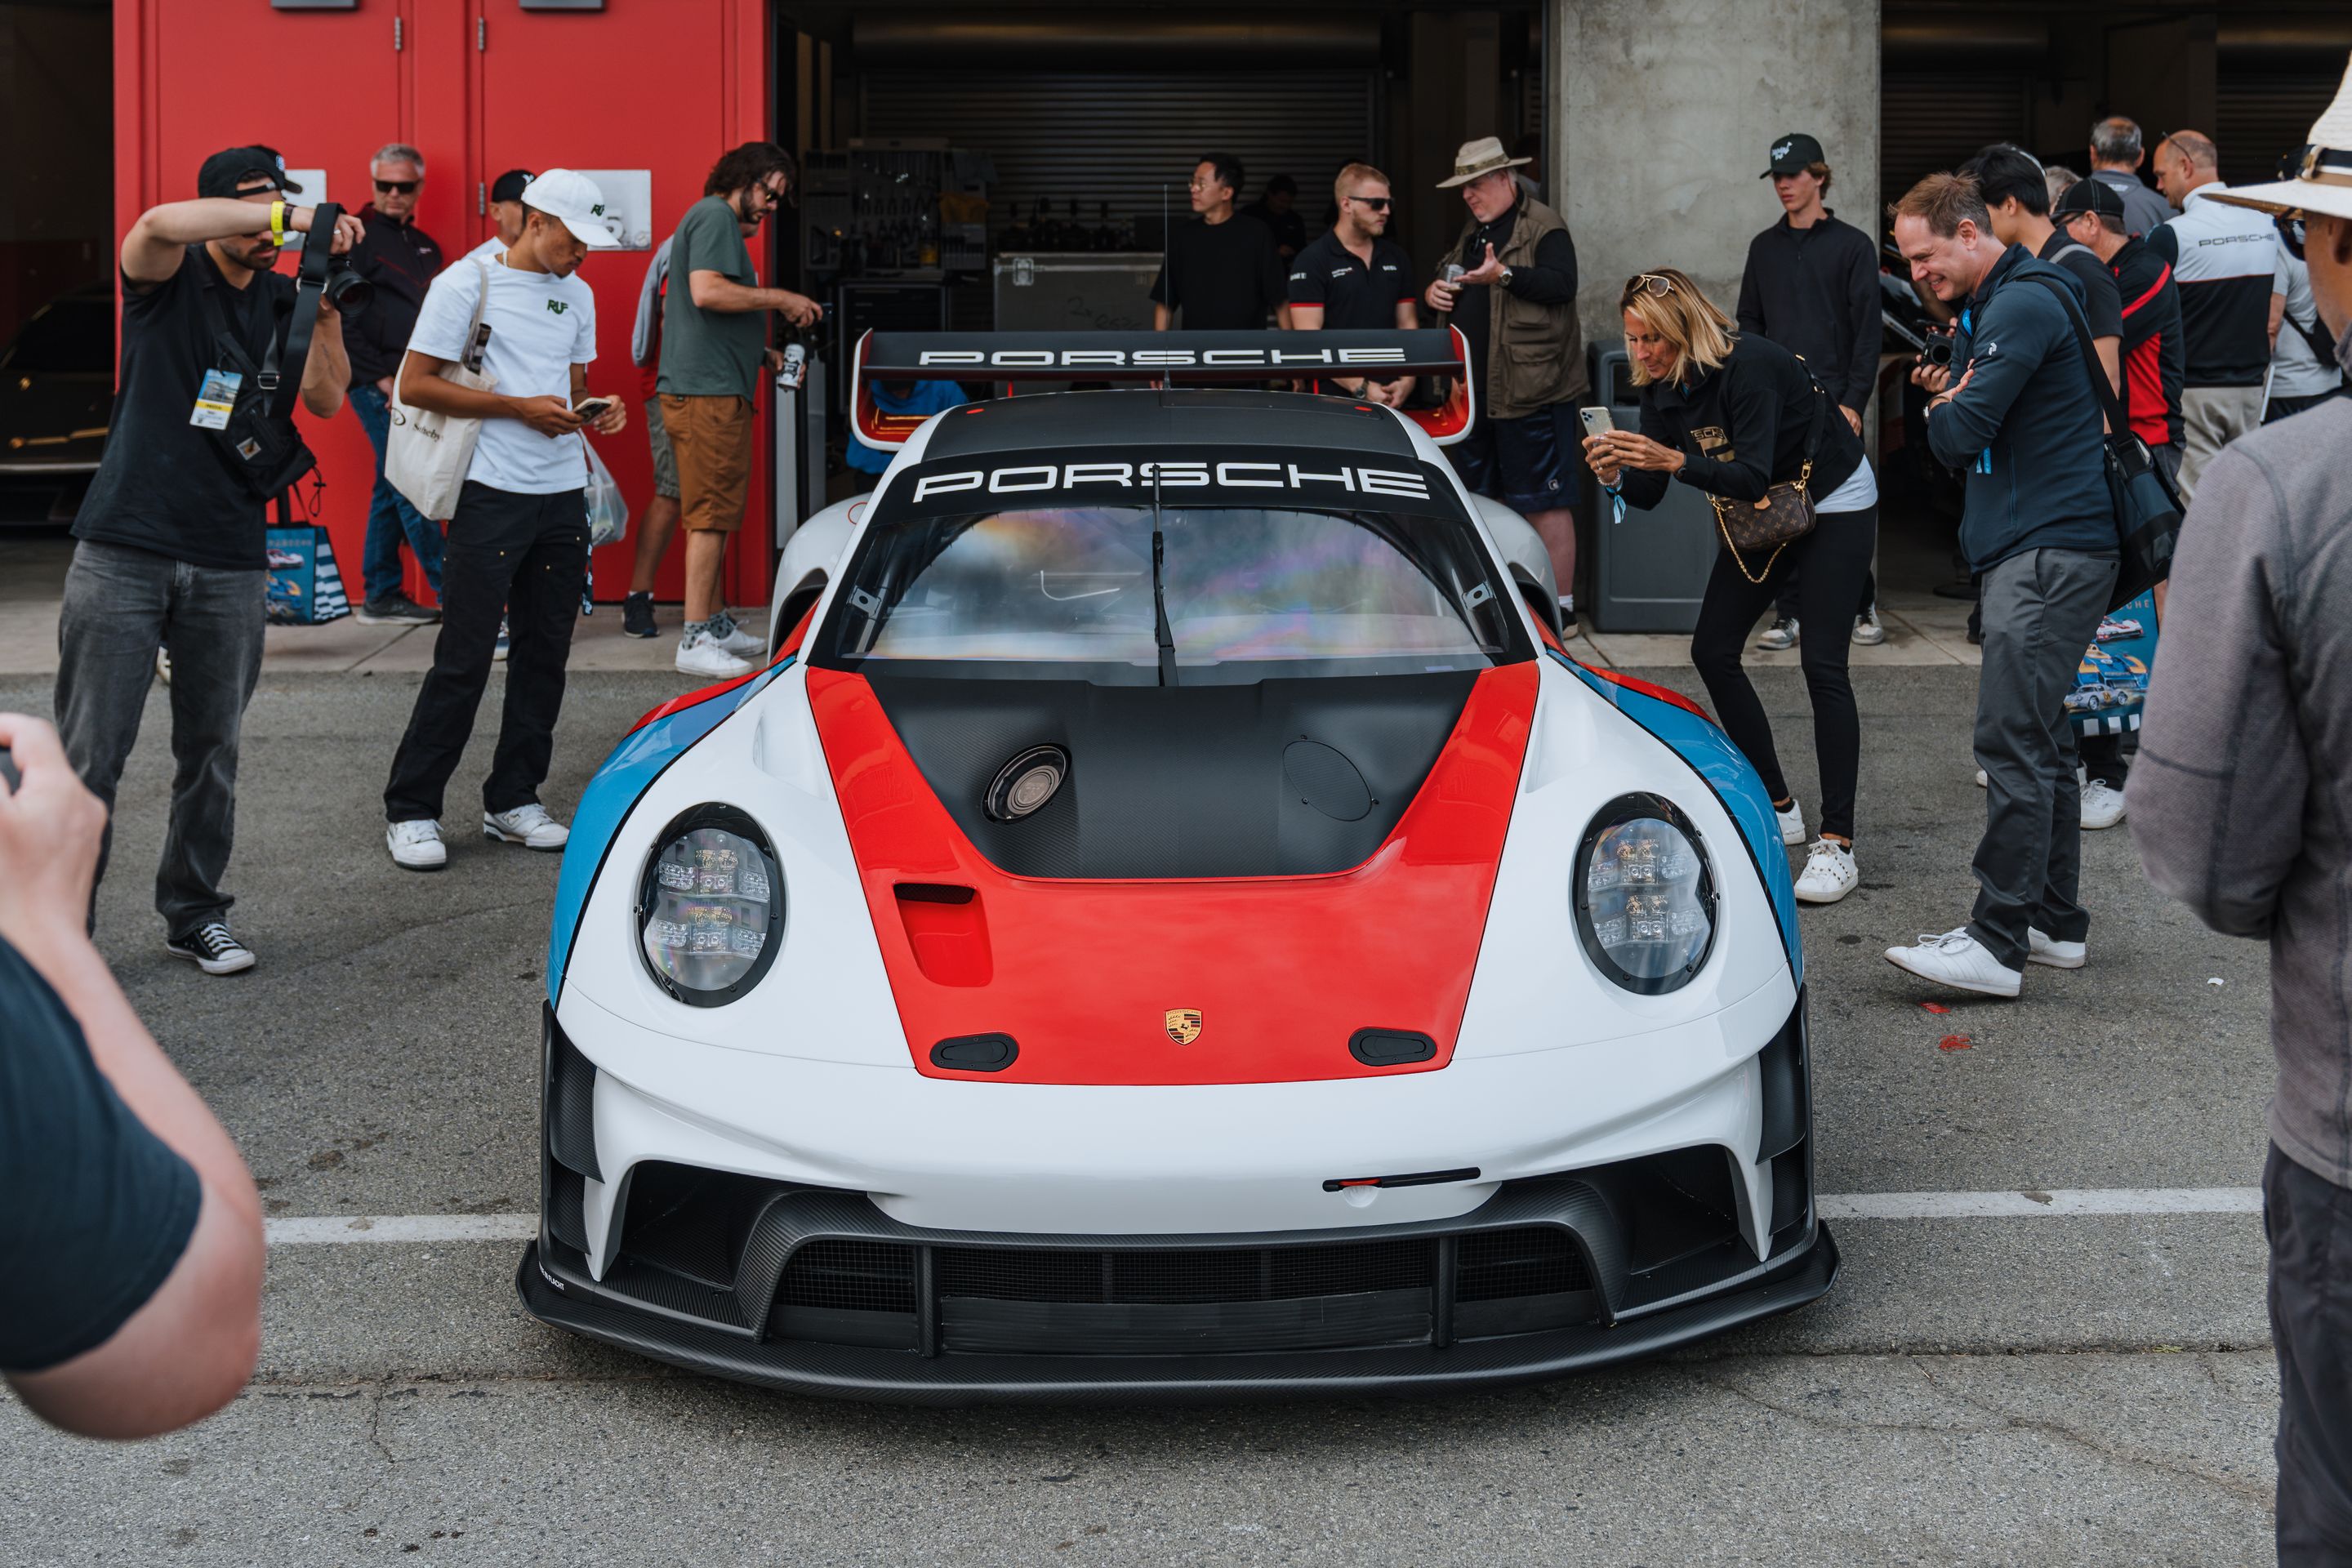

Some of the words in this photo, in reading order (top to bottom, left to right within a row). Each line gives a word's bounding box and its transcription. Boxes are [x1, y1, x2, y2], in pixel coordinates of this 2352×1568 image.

[590, 203, 605, 216] RU
[2198, 234, 2274, 247] PORSCHE
[547, 299, 568, 314] RUF
[919, 348, 1405, 366] PORSCHE
[913, 462, 1430, 502] PORSCHE
[2120, 599, 2149, 610] CHE
